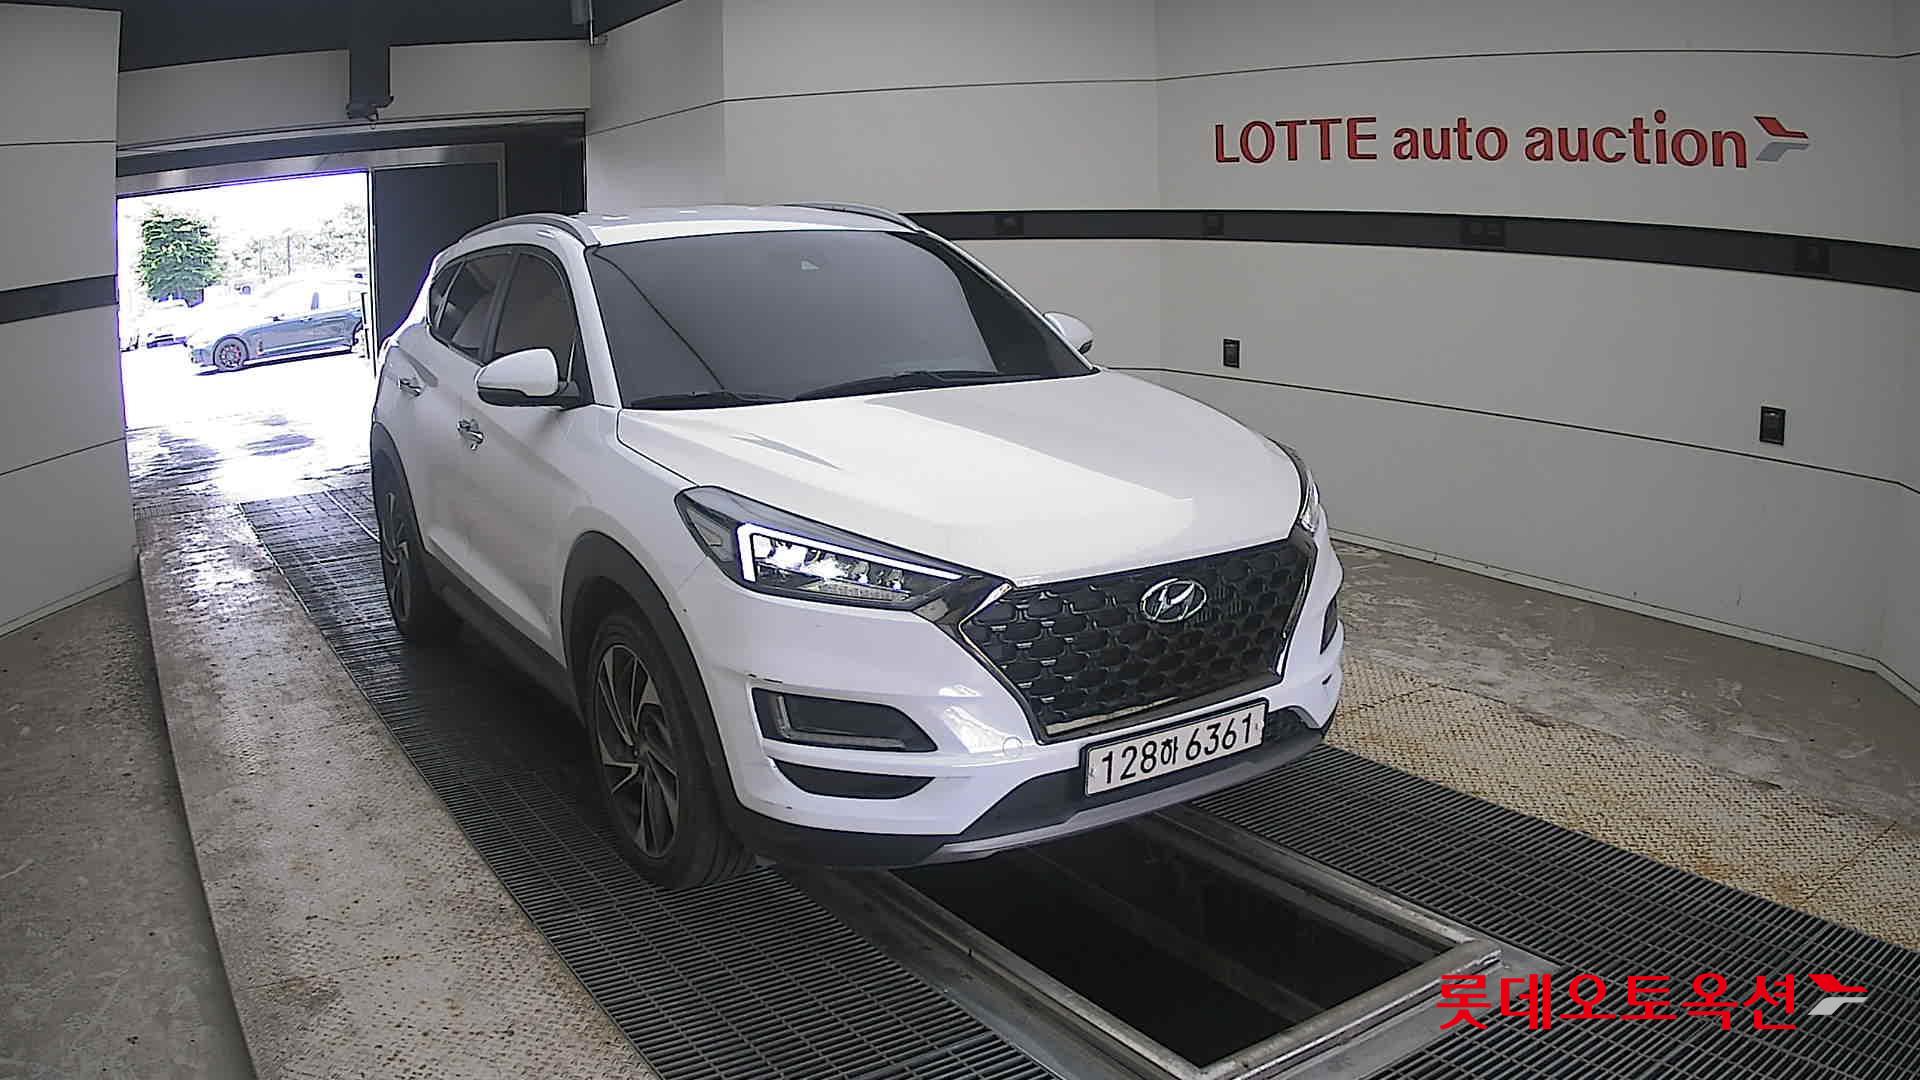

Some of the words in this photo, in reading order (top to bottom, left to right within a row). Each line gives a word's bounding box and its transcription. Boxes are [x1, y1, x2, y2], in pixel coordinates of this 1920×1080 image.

[1215, 117, 1377, 163] LOTTE
[1393, 117, 1508, 161] auto
[1525, 109, 1748, 169] auction
[1101, 735, 1178, 784] 128하
[1185, 712, 1252, 761] 6361
